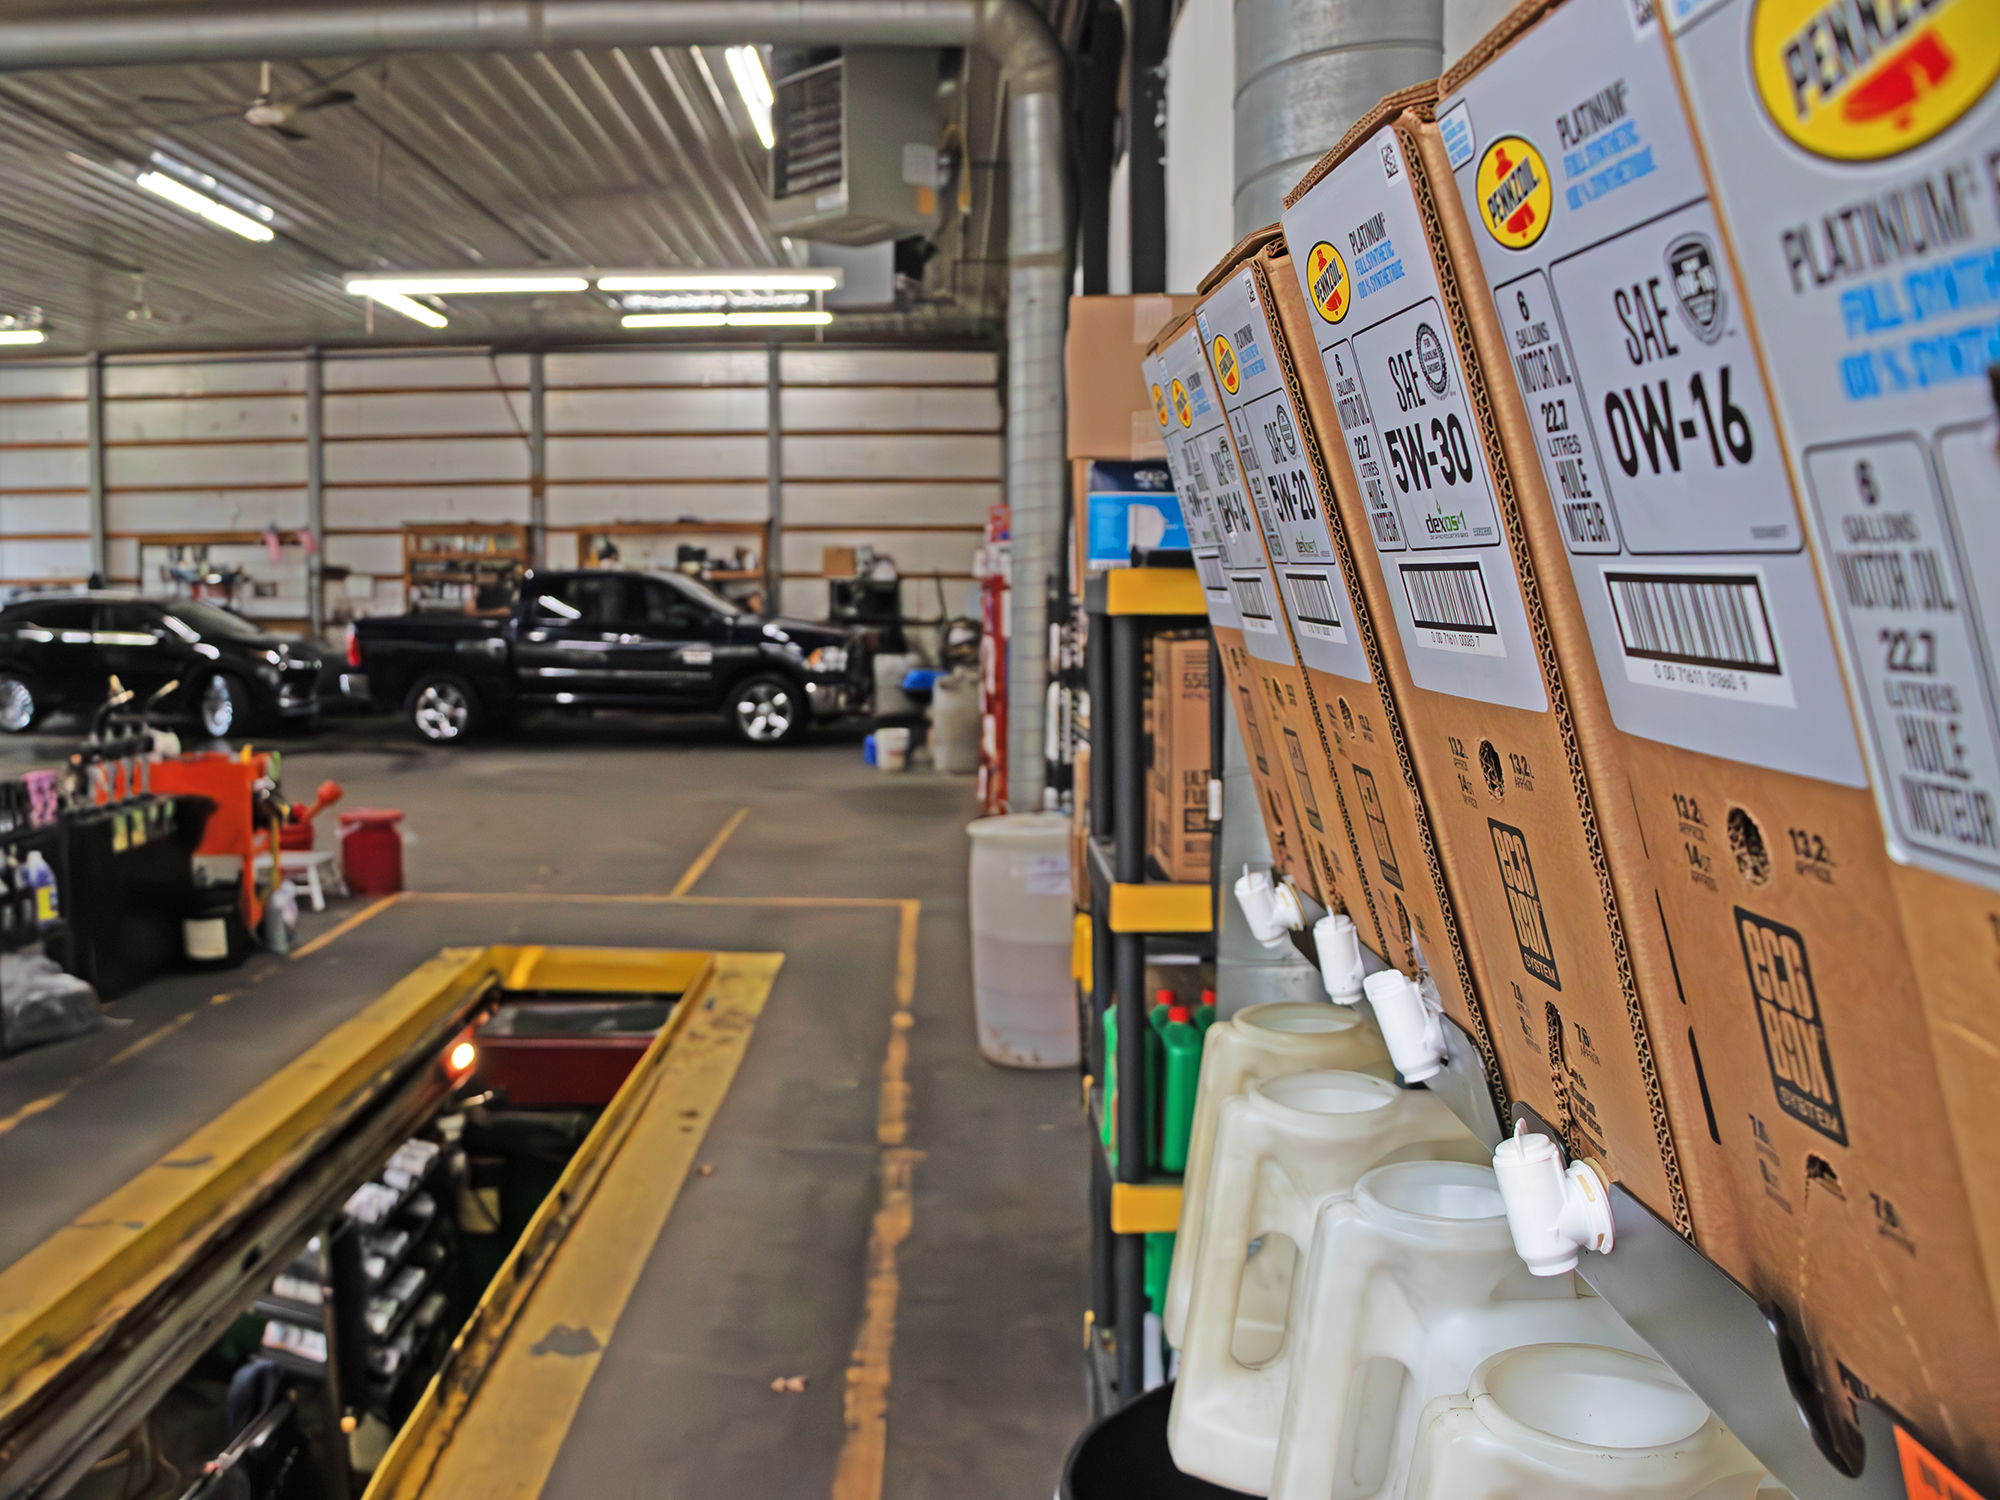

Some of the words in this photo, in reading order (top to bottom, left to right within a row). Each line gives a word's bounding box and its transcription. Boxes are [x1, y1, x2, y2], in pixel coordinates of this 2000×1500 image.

[1348, 212, 1386, 256] PLATINUM
[1782, 170, 1971, 294] PLATINUM
[1313, 256, 1343, 308] PENNZOIL
[1516, 291, 1530, 322] 6
[1613, 277, 1679, 365] SAE
[1515, 321, 1550, 349] GALLONS
[1334, 353, 1344, 377] 6
[1336, 377, 1356, 396] GALLONS
[1388, 349, 1427, 413] SAE
[1515, 348, 1555, 394] MOTOR
[1547, 343, 1572, 385] OIL
[1336, 396, 1362, 430] MOTOR
[1354, 393, 1370, 425] OIL
[1541, 399, 1570, 433] 22.7
[1604, 364, 1754, 478] 0W-16
[1264, 421, 1287, 464] SAE
[1354, 435, 1371, 461] 22.7
[1384, 412, 1473, 494] 5W-30
[1547, 434, 1581, 459] LITRES
[1358, 460, 1380, 479] LITRES
[1555, 458, 1593, 500] HUILE
[1855, 459, 1879, 506] 6
[1268, 468, 1316, 522] 5W-20
[1563, 500, 1611, 543] MOTEUR
[1842, 513, 1917, 544] GALLONS
[1836, 551, 1912, 611] MOTOR
[1910, 550, 1956, 614] OIL
[1524, 952, 1558, 983] SYSTEM
